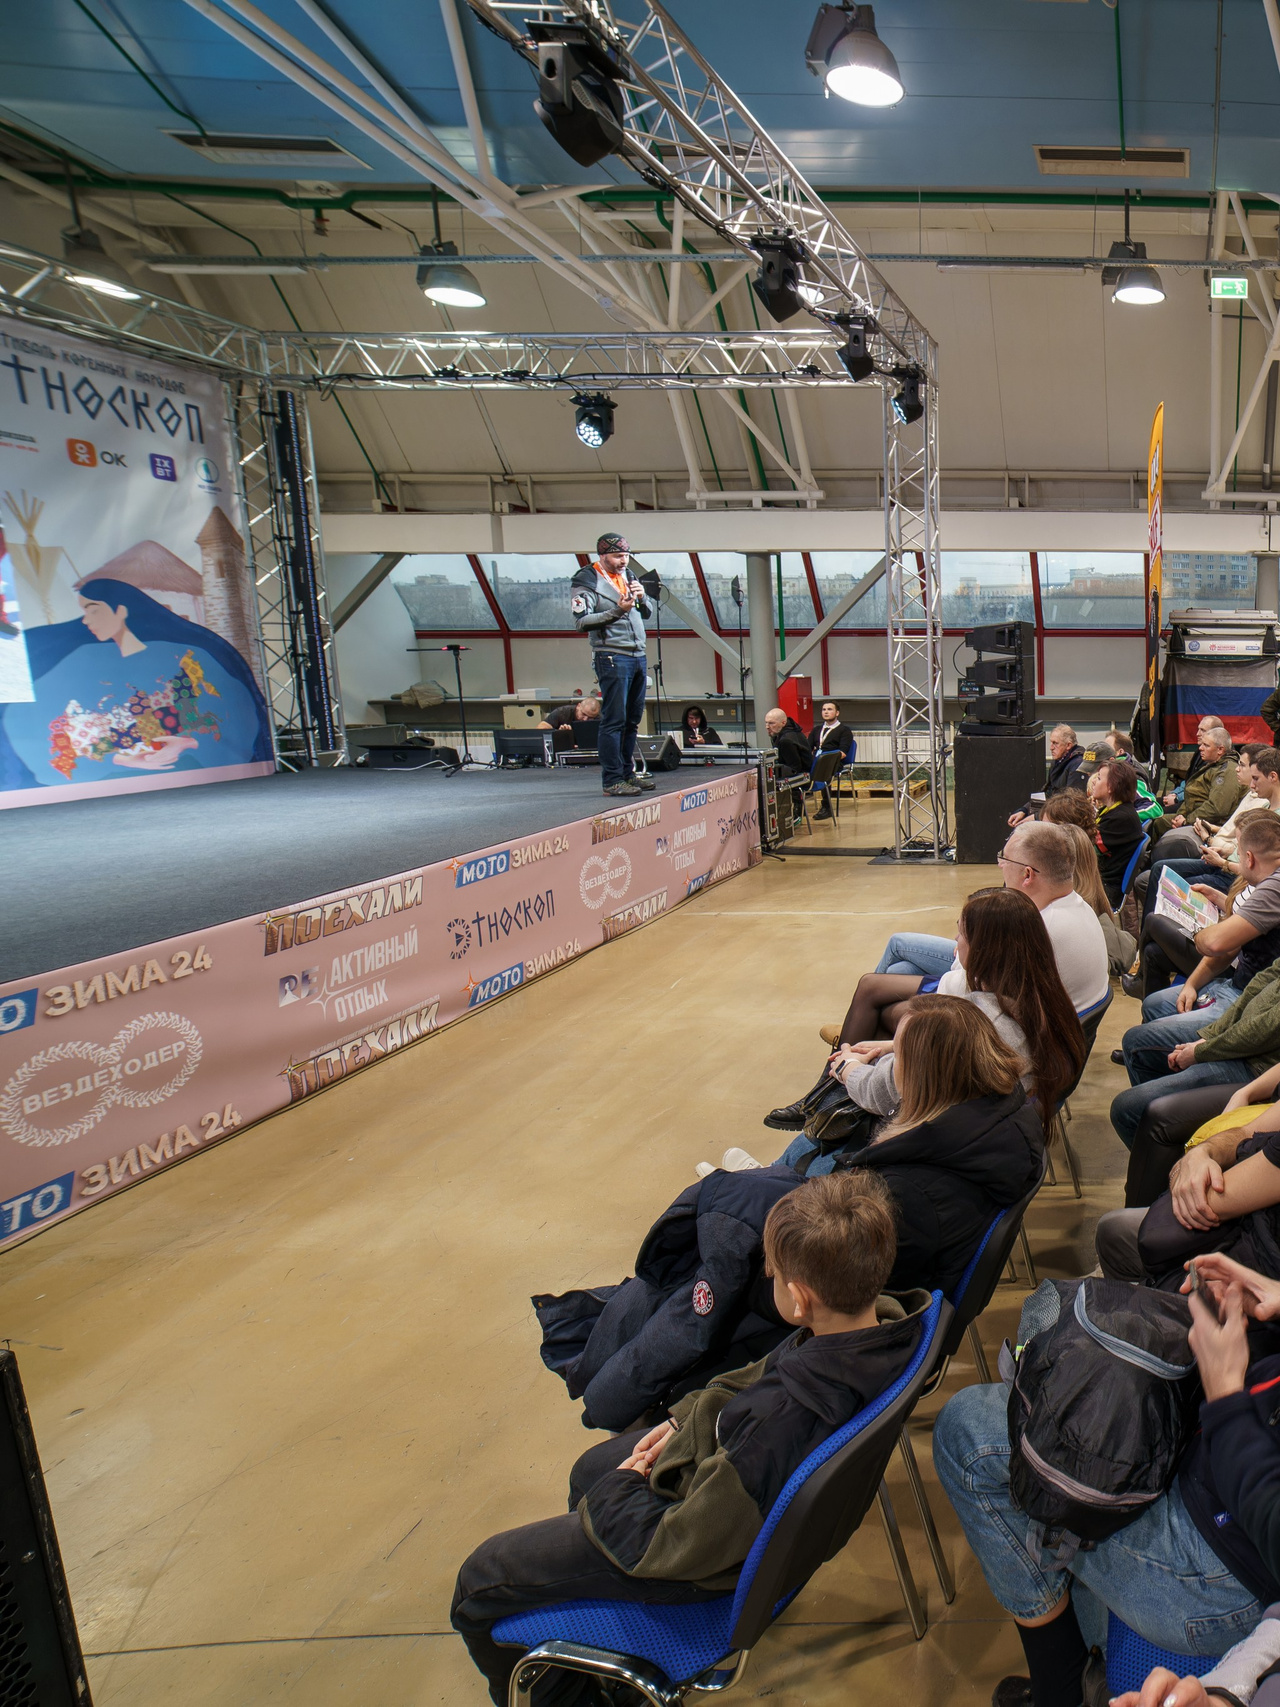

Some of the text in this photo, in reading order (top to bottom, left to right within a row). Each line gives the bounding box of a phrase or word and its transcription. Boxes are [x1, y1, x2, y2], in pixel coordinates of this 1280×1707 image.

[0, 354, 204, 444] ТНОСКОП
[591, 802, 661, 845] ПОЕХАЛИ
[683, 791, 705, 810] МОТО
[708, 785, 730, 803] ЗИМА
[462, 835, 570, 884] МОТО ЗИМА 24
[673, 818, 707, 849] АКТИВНЫЙ
[675, 849, 695, 871] ОТДЫХ
[585, 865, 627, 890] ВЕЗДЕХОДЕР
[264, 875, 424, 956] ПОЕХАЛИ
[600, 890, 668, 941] ПОЕХАЛИ
[44, 959, 168, 1018] ЗИМА
[171, 945, 214, 981] 24
[330, 924, 419, 987] АКТИВНЫЙ
[476, 938, 582, 1002] МОТО ЗИМА 24
[334, 979, 389, 1023] ОТДЫХ
[22, 1040, 186, 1116] ВЕЗДЕХОДЕР
[289, 1000, 440, 1103] ПОЕХАЛИ
[1, 1103, 243, 1234] ТО ЗИМА 24
